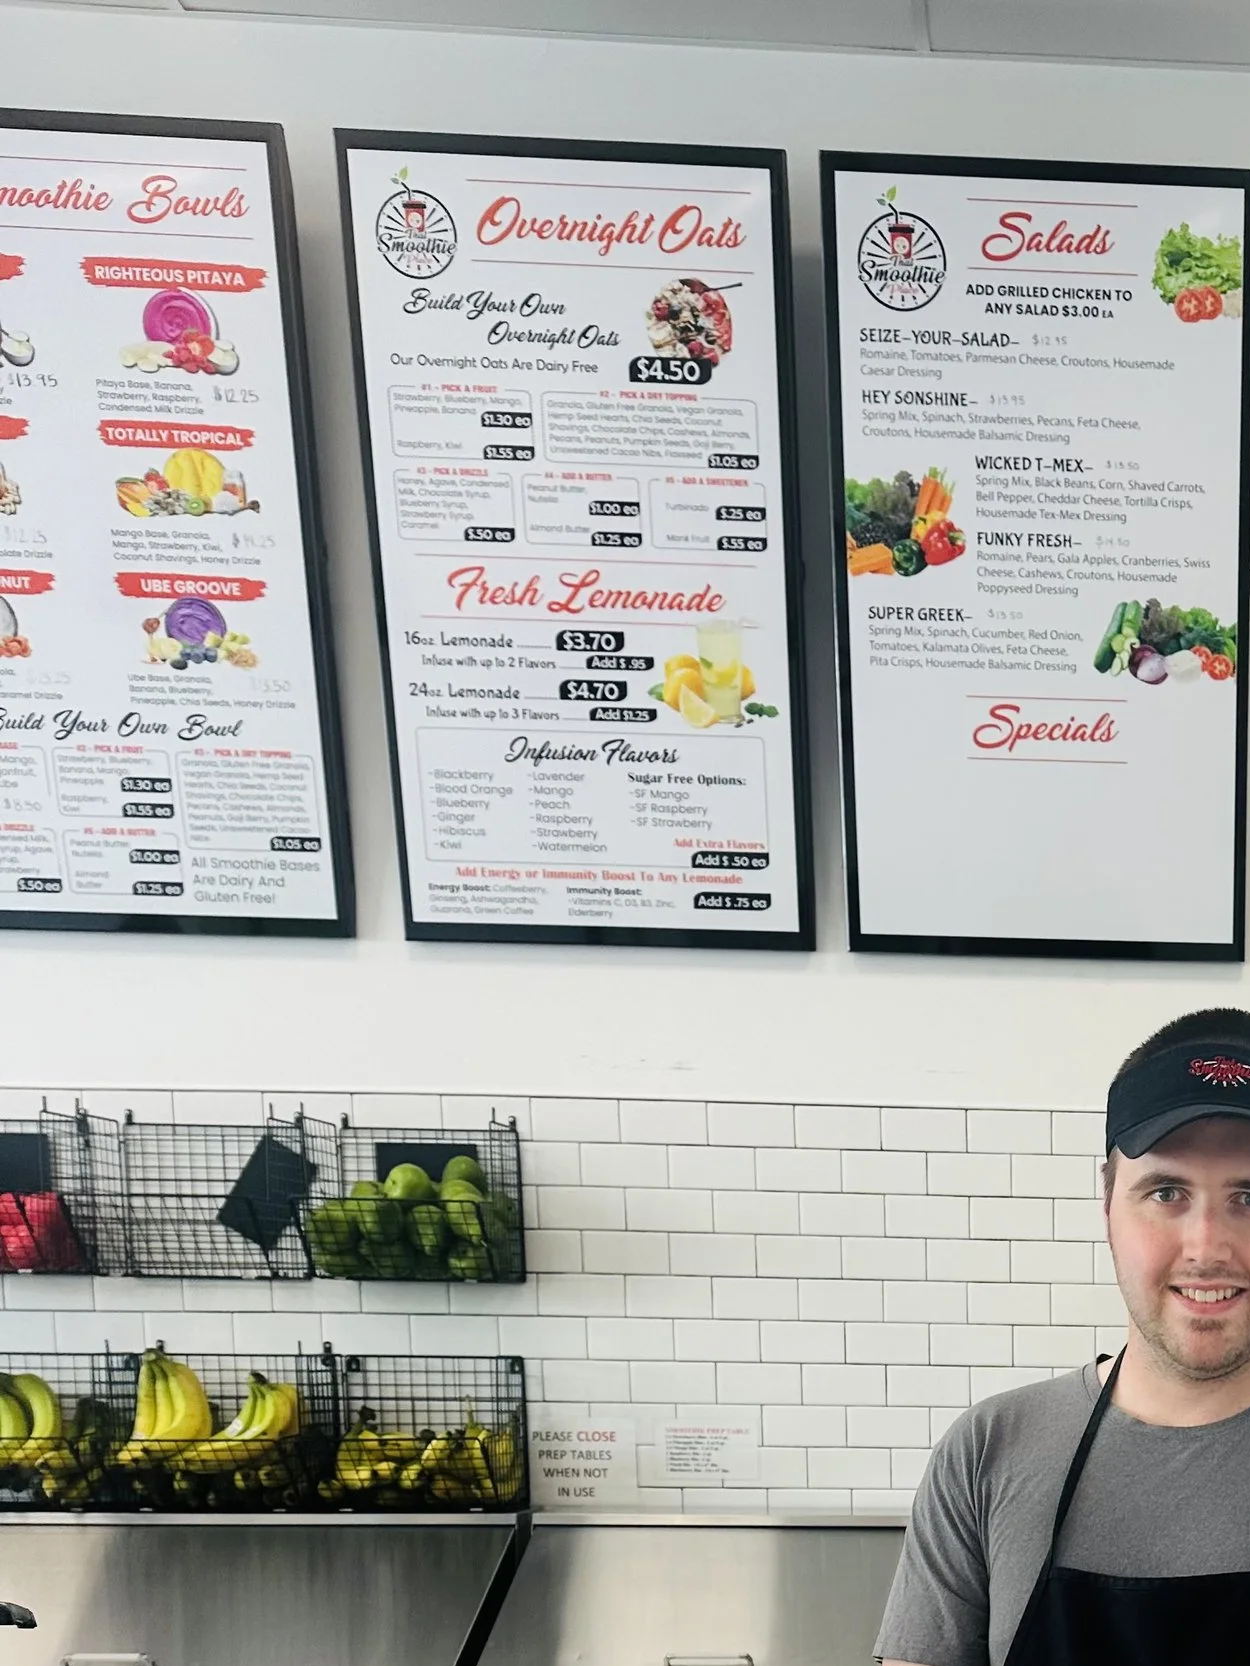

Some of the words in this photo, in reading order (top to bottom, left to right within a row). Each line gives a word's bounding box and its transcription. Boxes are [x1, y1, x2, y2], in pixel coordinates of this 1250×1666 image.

[127, 175, 250, 224] Bowls
[476, 196, 654, 256] Overnight
[658, 205, 747, 253] Oats
[377, 233, 457, 256] Smoothie
[981, 211, 1115, 262] Salads
[94, 265, 185, 283] RIGHTEOUS
[187, 273, 245, 286] PITAYA
[859, 259, 946, 285] Smoothie
[966, 283, 994, 296] ADD
[997, 284, 1049, 298] GRILLED
[1052, 286, 1110, 301] CHICKEN
[1112, 289, 1133, 301] TO
[403, 287, 463, 314] Build
[466, 291, 517, 320] Your
[519, 293, 566, 316] Own
[985, 302, 1012, 315] ANY
[1015, 303, 1059, 317] SALAD
[1062, 303, 1099, 318] $3.00
[1102, 309, 1113, 318] EA
[487, 320, 576, 350] Overnight
[577, 324, 622, 349] Oats
[390, 353, 411, 366] Our
[414, 354, 476, 371] Overnight
[481, 357, 507, 370] Oats
[512, 358, 533, 370] Are
[537, 359, 568, 375] Dairy
[572, 360, 598, 373] Free
[636, 358, 700, 381] $4.50
[862, 390, 892, 405] HEY
[106, 426, 168, 443] TOTALLY
[172, 429, 244, 446] TROPICAL
[975, 456, 1032, 472] WICKED
[977, 532, 1023, 548] FUNKY
[141, 578, 171, 593] UBE
[173, 580, 242, 596] GROOVE
[447, 566, 543, 611] Fresh
[547, 568, 728, 614] Lemonade
[868, 606, 915, 621] SUPER
[441, 631, 513, 648] Lemonade
[563, 631, 616, 650] $3.70
[422, 654, 453, 666] Infuse
[456, 655, 477, 667] with
[480, 657, 493, 670] up
[495, 655, 506, 667] to
[508, 657, 515, 667] 2
[518, 656, 556, 669] Flavors
[591, 656, 617, 668] Add
[448, 683, 520, 699] Lemonade
[566, 681, 620, 699] $4.70
[426, 705, 457, 718] Infuse
[459, 706, 481, 719] with
[484, 708, 496, 721] up
[499, 707, 509, 719] to
[512, 708, 519, 719] 3
[522, 708, 560, 721] Flavors
[595, 709, 620, 720] Add
[0, 707, 45, 731] uild
[53, 709, 109, 741] Your
[118, 712, 170, 738] Own
[178, 714, 243, 741] Bowl
[972, 704, 1120, 752] Specials
[504, 736, 599, 764] Infusion
[601, 738, 680, 765] Flavors
[628, 773, 663, 787] Sugar
[667, 774, 693, 785] Free
[697, 774, 746, 788] Options:
[530, 813, 593, 827] -Raspberry
[530, 827, 598, 841] -Strawberry
[532, 841, 608, 854] -Watermelon
[191, 857, 207, 868] All
[210, 857, 275, 871] Smoothie
[279, 859, 320, 871] Bases
[193, 874, 215, 886] Are
[219, 875, 254, 889] Dairy
[258, 876, 284, 888] And
[194, 891, 239, 903] Gluten
[243, 892, 275, 904] Free!
[532, 1431, 573, 1442] PLEASE
[577, 1431, 616, 1442] CLOSE
[538, 1450, 566, 1460] PREP
[571, 1450, 612, 1460] TABLES
[543, 1468, 579, 1478] WHEN
[583, 1468, 608, 1478] NOT
[558, 1487, 570, 1497] IN
[573, 1487, 595, 1497] USE
